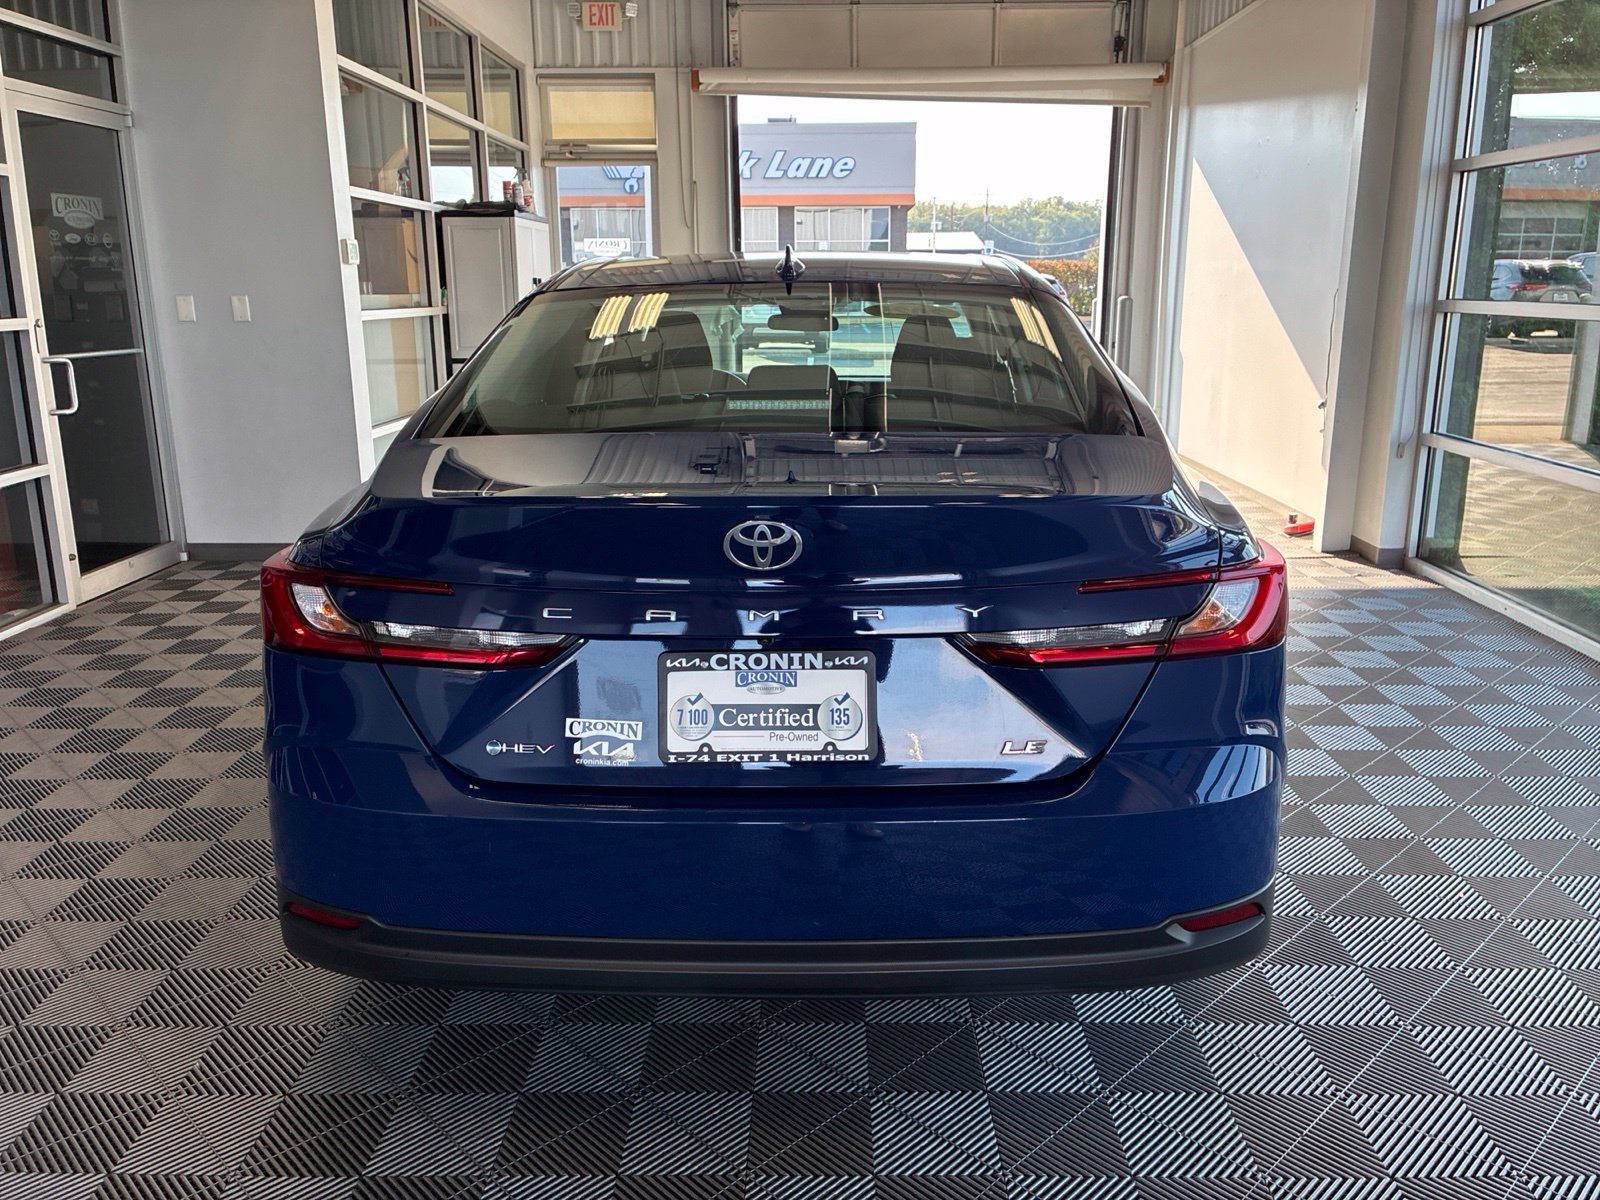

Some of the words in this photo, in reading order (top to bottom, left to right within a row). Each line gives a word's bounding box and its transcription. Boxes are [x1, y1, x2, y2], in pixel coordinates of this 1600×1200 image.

[588, 3, 616, 26] EXIT
[763, 150, 856, 179] Lane
[55, 195, 102, 219] CRONIN
[542, 605, 994, 622] CAMRY
[709, 652, 823, 670] CRONIN
[737, 671, 796, 686] CRONIN
[677, 709, 684, 726] 7
[688, 709, 708, 726] 100
[718, 708, 815, 727] Certified
[829, 708, 850, 726] 135
[568, 720, 640, 739] CRONIN
[769, 732, 819, 741] Pre-Owned
[502, 743, 555, 754] HEV
[1000, 740, 1048, 756] LE
[575, 757, 629, 766] croninkia.com
[667, 754, 711, 763] I-74
[716, 753, 763, 762] EXIT
[769, 754, 780, 762] 1
[786, 753, 870, 761] Harrison
